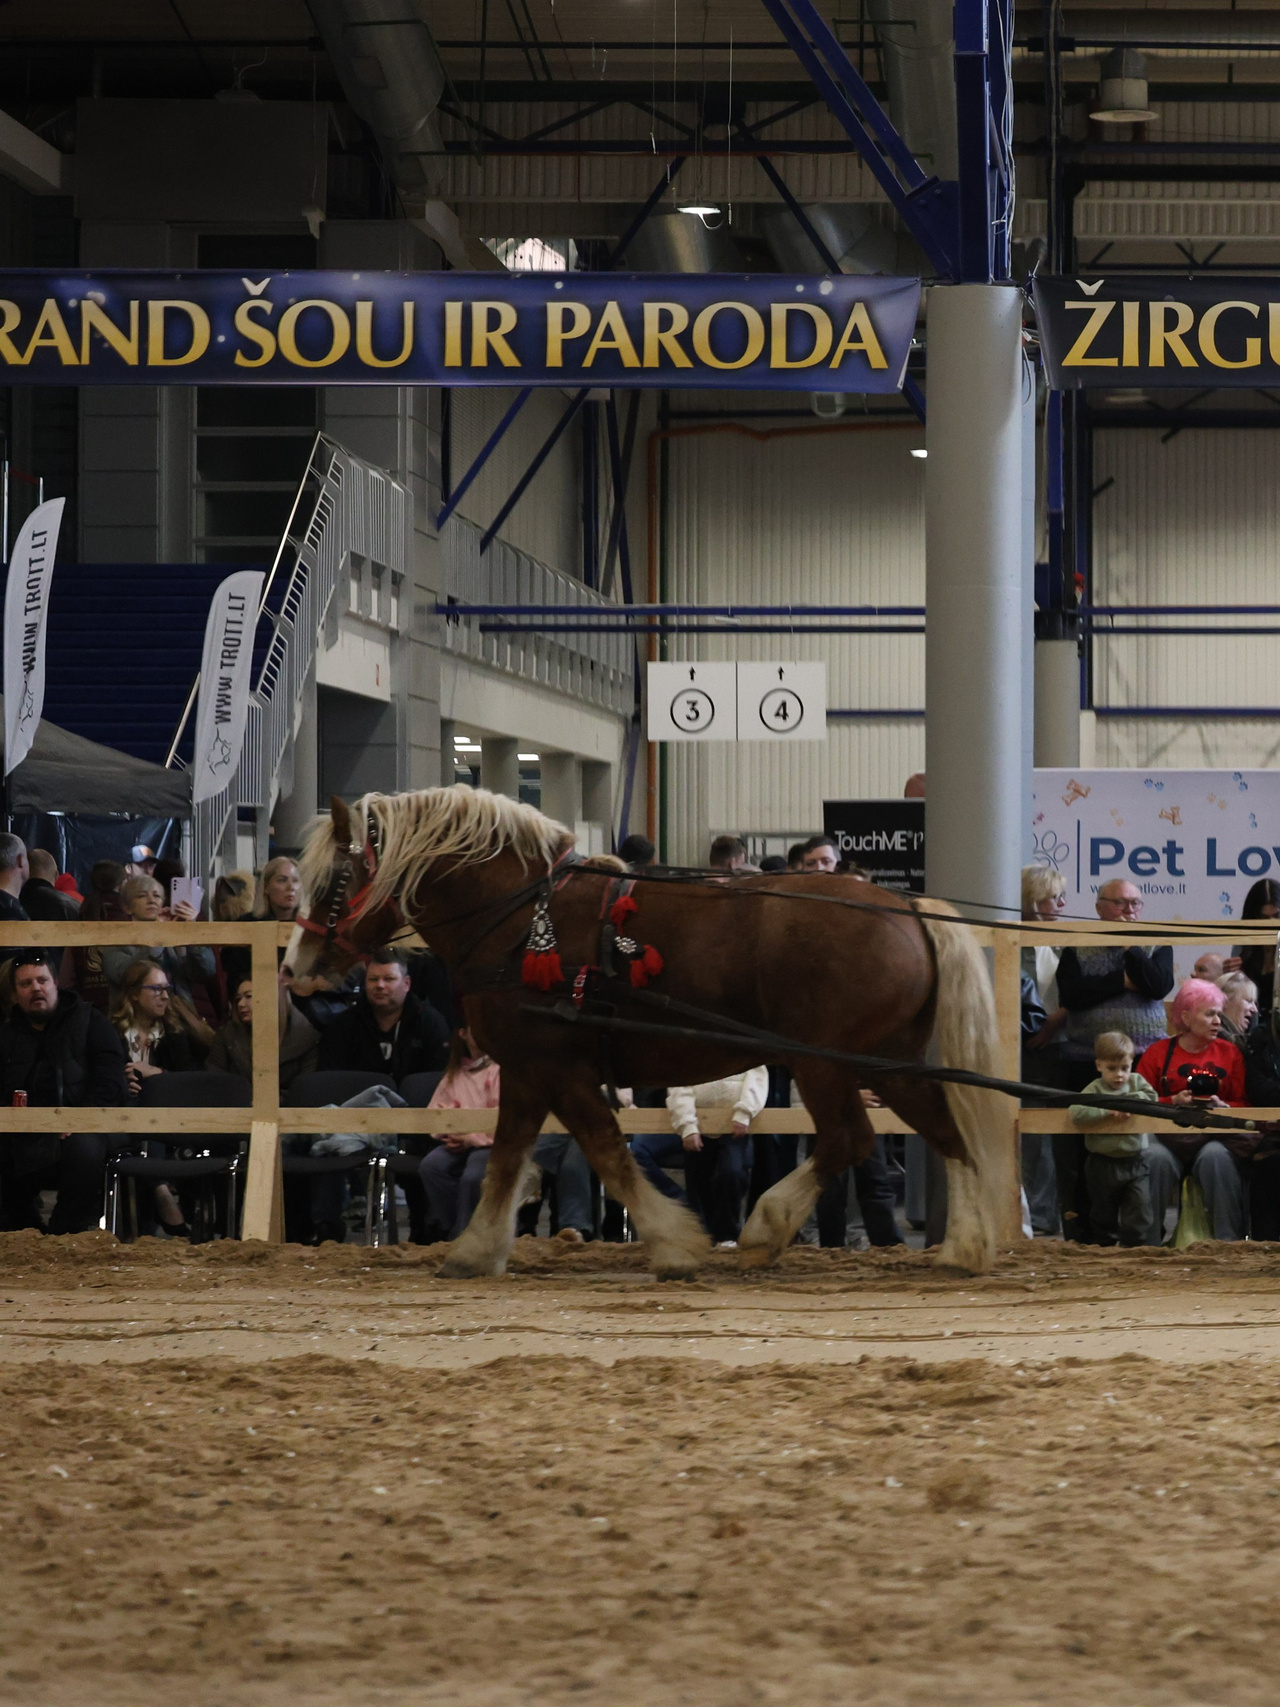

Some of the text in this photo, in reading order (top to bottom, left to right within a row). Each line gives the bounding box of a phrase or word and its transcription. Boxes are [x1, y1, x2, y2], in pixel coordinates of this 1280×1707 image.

[233, 277, 415, 368] ŠOU
[443, 300, 522, 368] IR
[545, 300, 890, 370] PARODA
[685, 700, 700, 722] 3
[774, 700, 789, 722] 4
[1089, 837, 1186, 877] Pet
